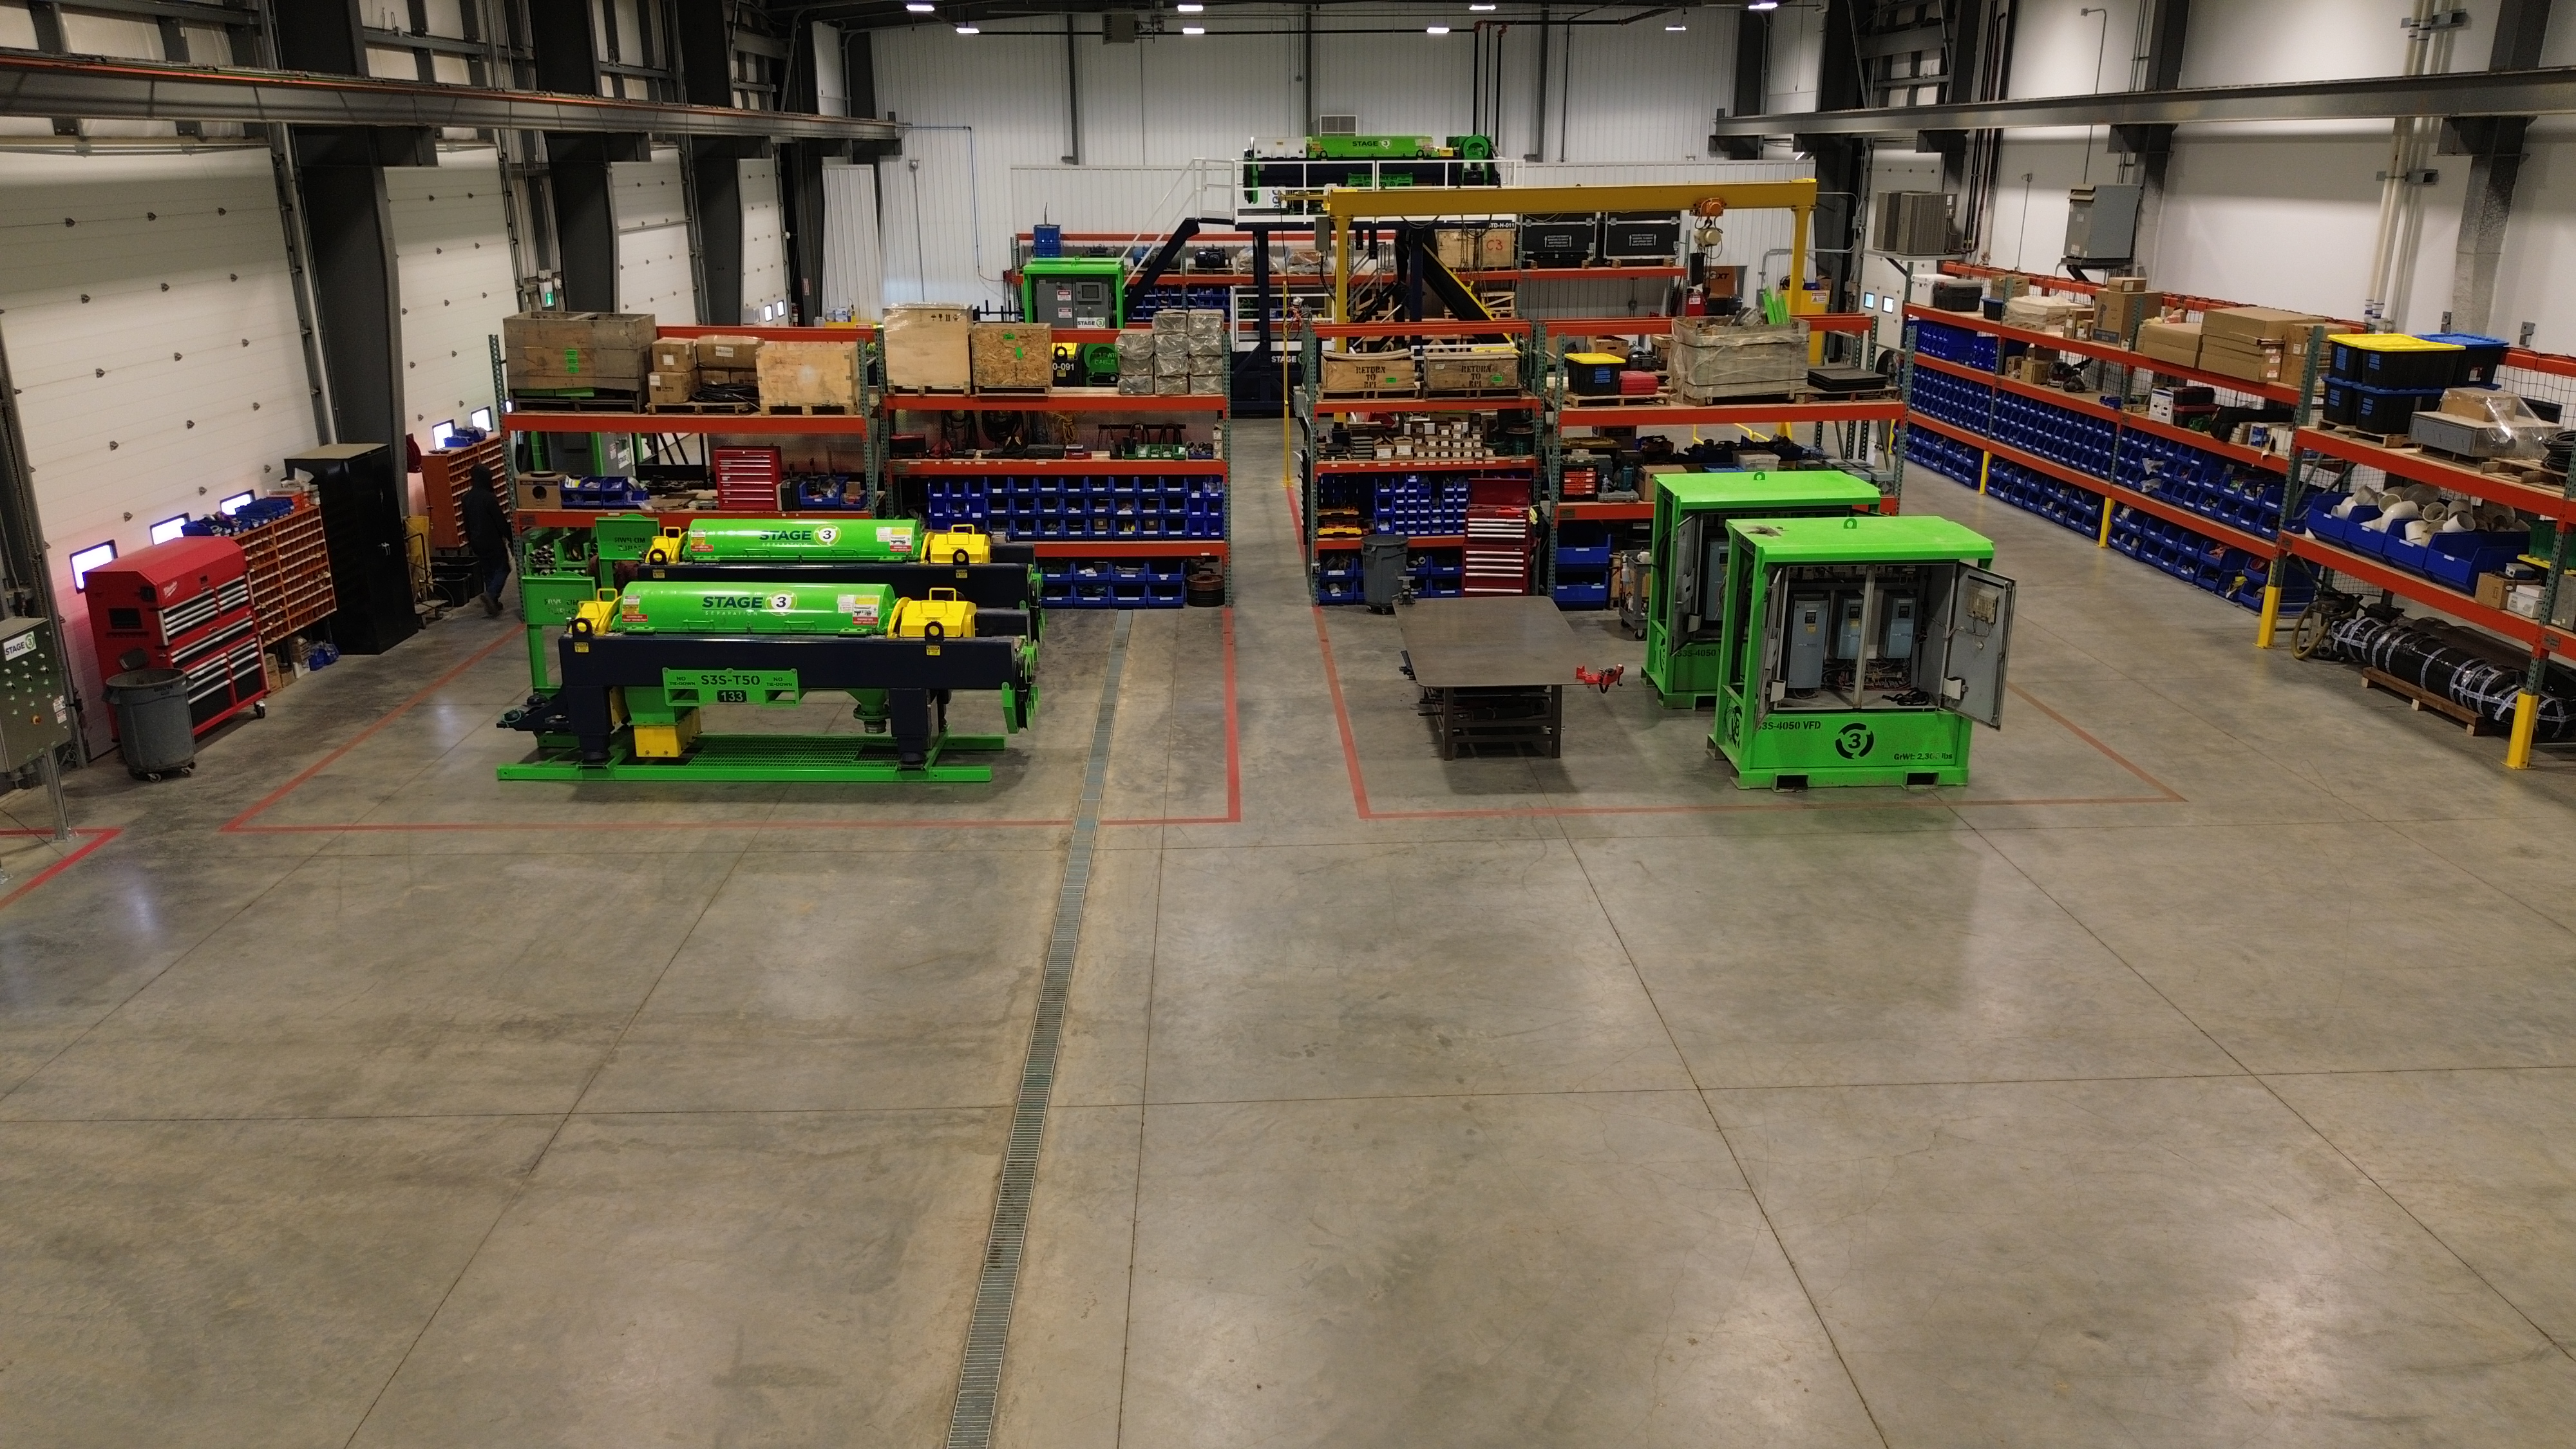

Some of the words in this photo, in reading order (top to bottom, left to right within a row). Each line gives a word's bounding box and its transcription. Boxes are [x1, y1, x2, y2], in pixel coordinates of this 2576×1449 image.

[1486, 239, 1503, 251] C3
[759, 530, 811, 540] STAGE
[822, 530, 832, 540] 3
[701, 596, 764, 609] STAGE
[776, 596, 787, 608] 3
[5, 642, 25, 656] STAGE
[1677, 649, 1716, 657] S3S-4050
[701, 675, 761, 685] S3S-T50
[721, 691, 743, 702] 133
[1803, 721, 1821, 730] VFD
[1848, 733, 1861, 749] 3
